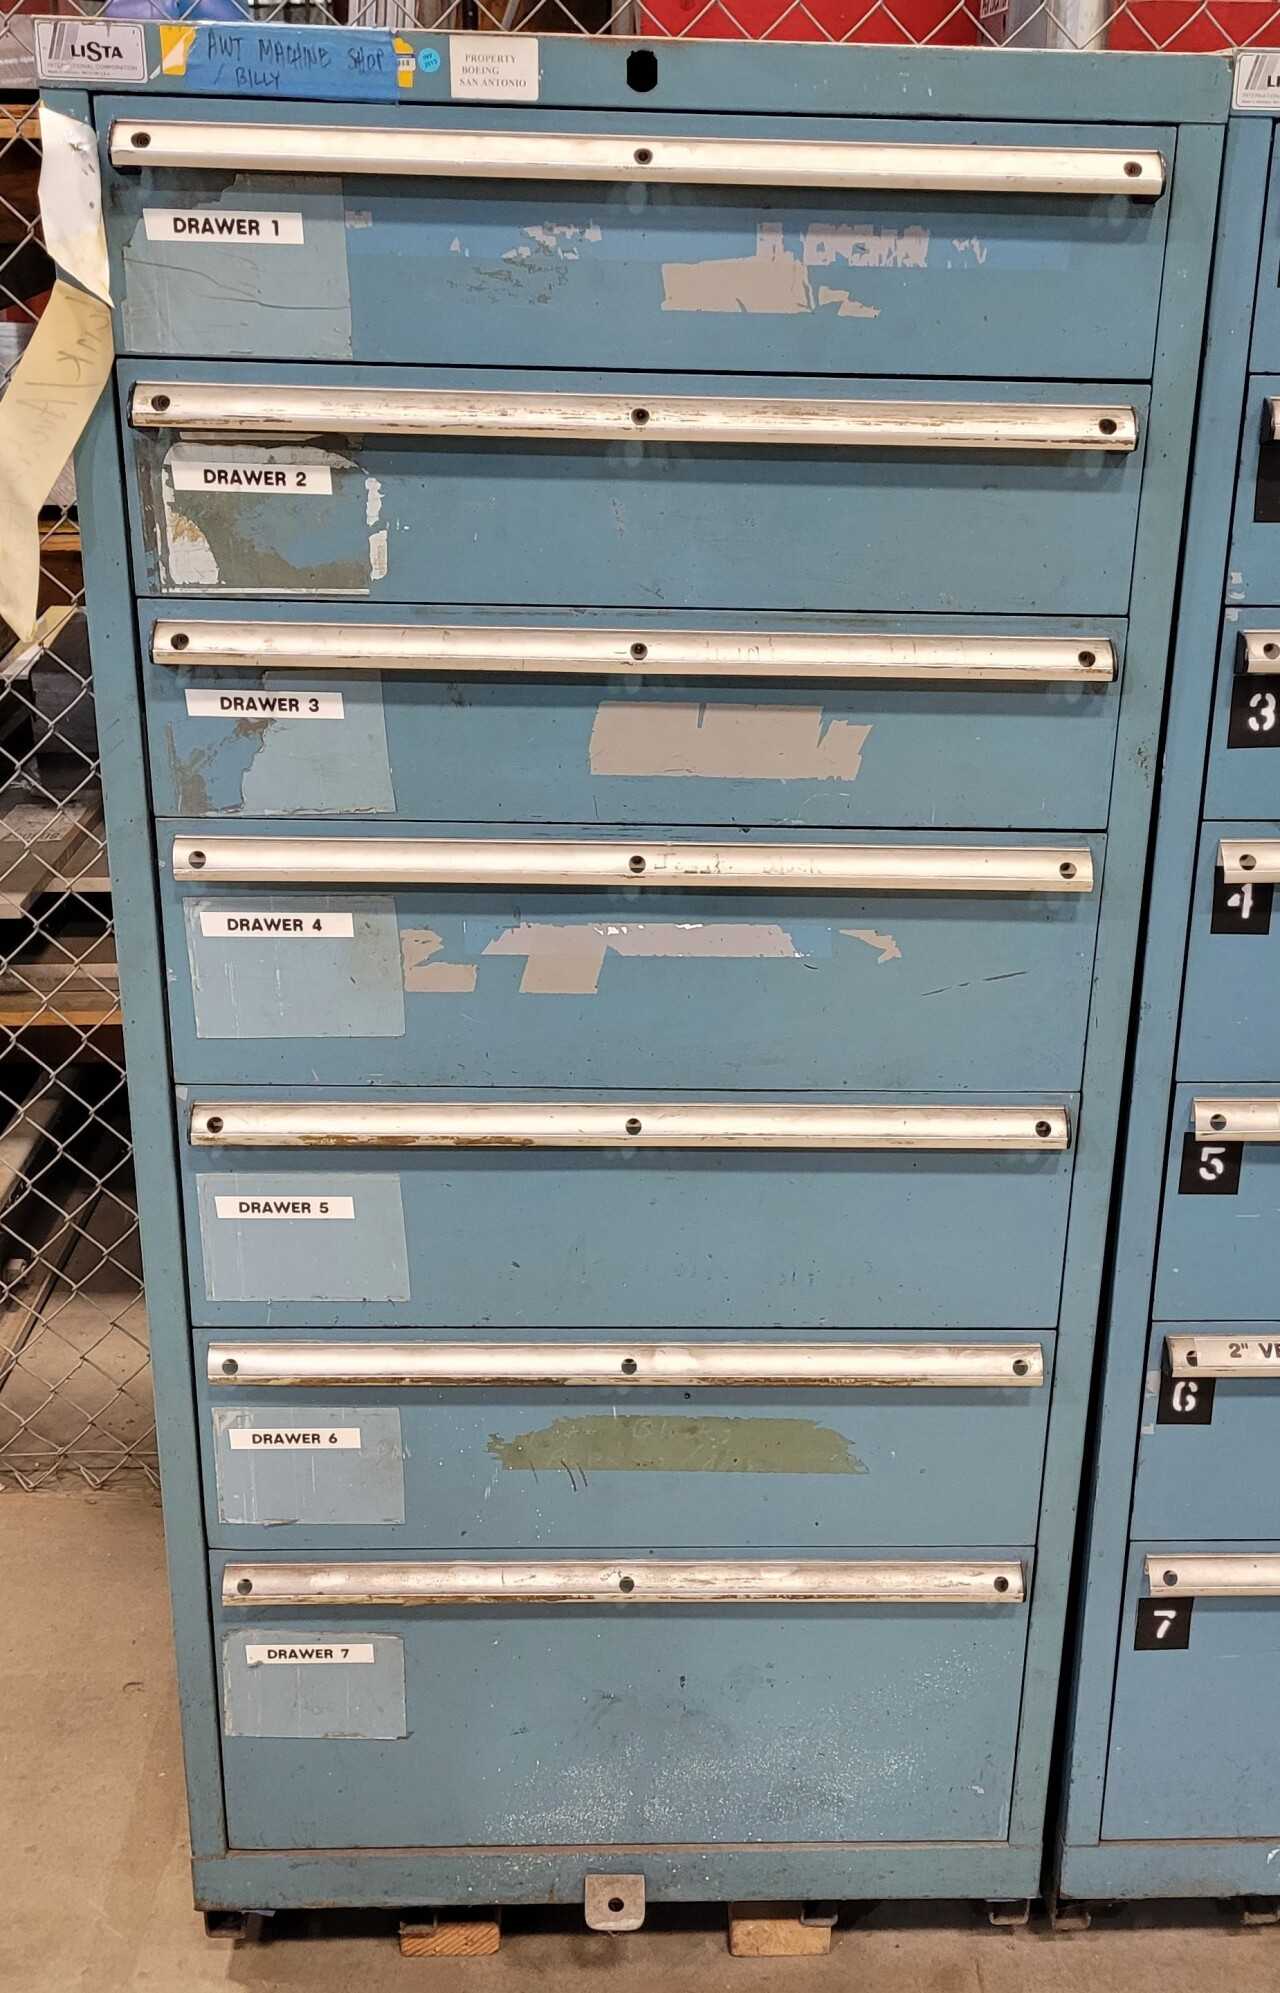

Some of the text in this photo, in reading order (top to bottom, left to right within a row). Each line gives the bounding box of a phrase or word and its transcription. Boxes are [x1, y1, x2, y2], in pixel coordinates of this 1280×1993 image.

[70, 41, 124, 62] LISTA
[207, 28, 243, 61] AWT
[258, 38, 333, 71] MACHINE
[347, 46, 385, 73] SHOP
[465, 54, 516, 64] PROPERTY
[235, 66, 280, 90] BILLY
[462, 66, 500, 75] BOEING
[459, 78, 527, 88] SAN ANTONIO
[173, 217, 279, 236] DRAWER 1
[204, 469, 306, 487] DRAWER 2
[220, 697, 319, 712] DRAWER 3
[1248, 694, 1276, 731] 3
[227, 918, 322, 931] DRAWER 4
[1199, 1146, 1226, 1181] 5
[239, 1202, 328, 1213] DRAWER 5
[1228, 1342, 1249, 1359] 2"
[1172, 1382, 1198, 1412] 6
[252, 1433, 337, 1444] DRAWER 6
[1153, 1609, 1177, 1639] 7
[267, 1649, 349, 1659] DRAWER 7
